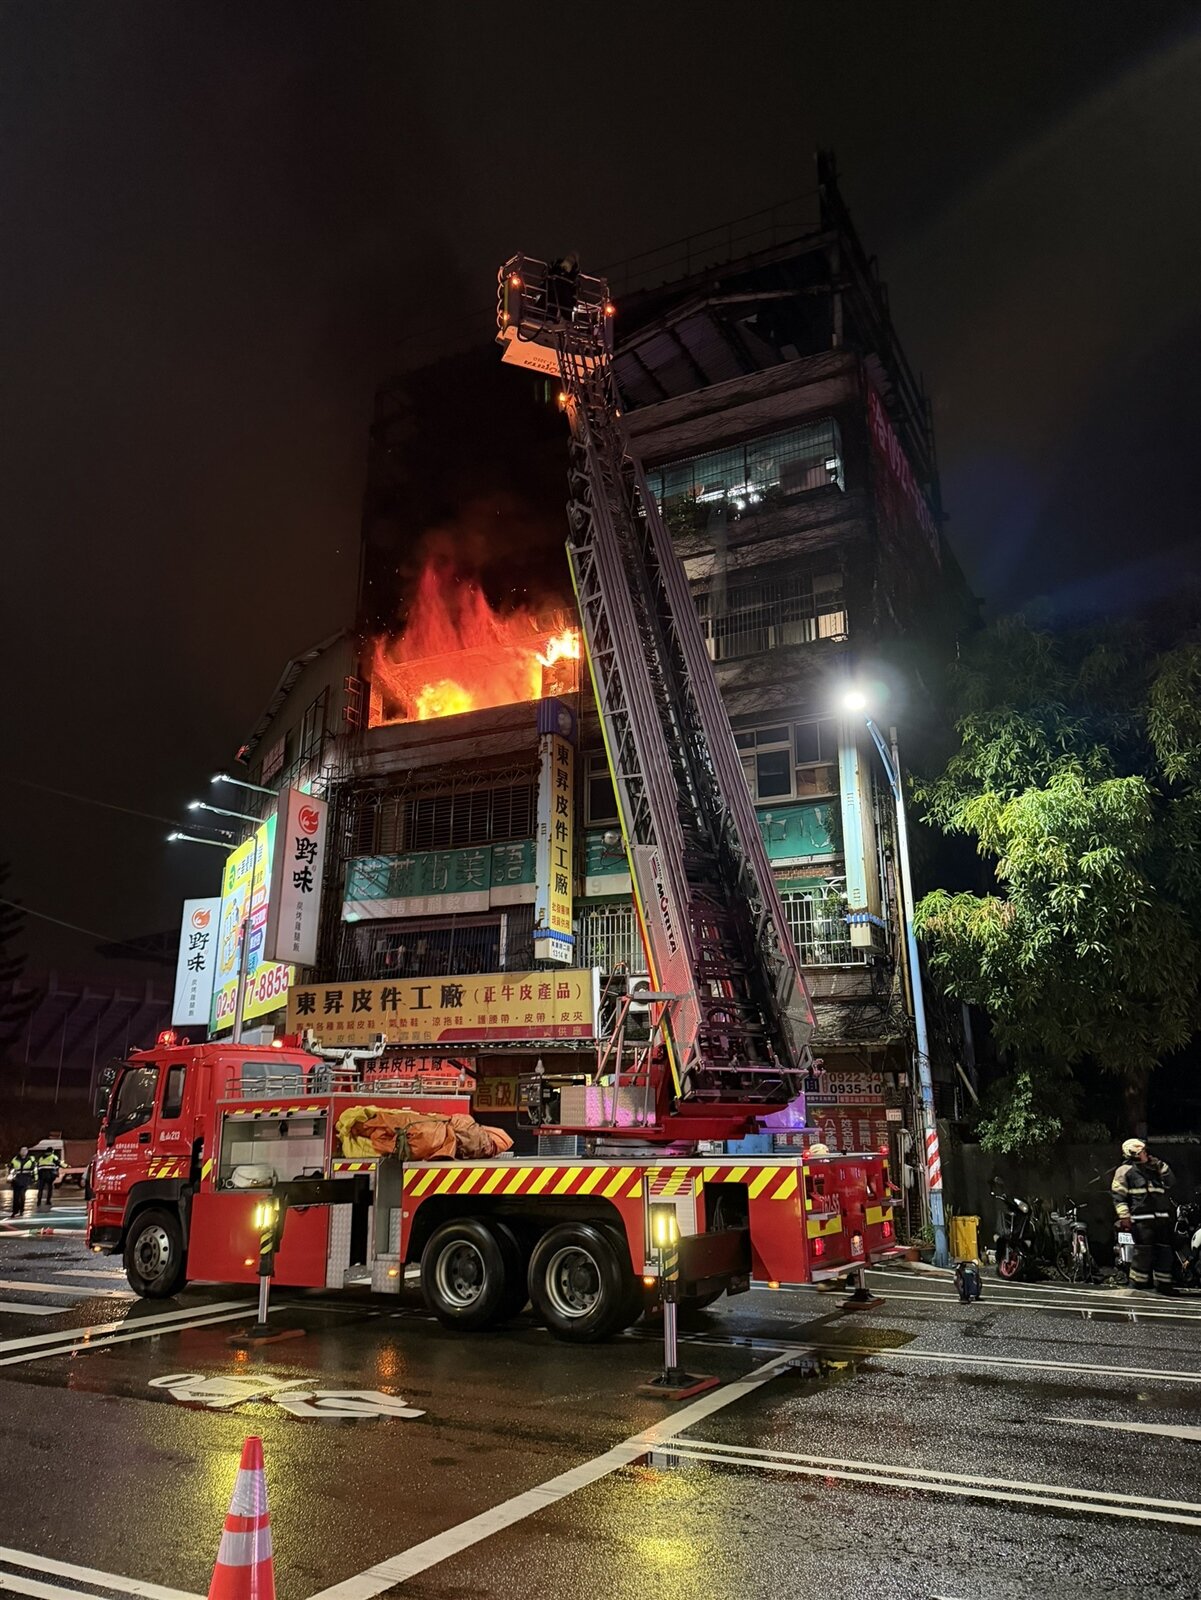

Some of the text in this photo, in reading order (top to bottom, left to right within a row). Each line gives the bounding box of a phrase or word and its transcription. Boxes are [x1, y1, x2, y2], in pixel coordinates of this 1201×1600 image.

[554, 742, 569, 896] 東昇皮件工廠
[292, 836, 318, 894] 野味
[656, 882, 677, 953] MORITA
[187, 931, 210, 973] 野味
[295, 983, 464, 1017] 東昇皮件工廠
[476, 1083, 514, 1107] 高級
[829, 1084, 882, 1094] 0935-10
